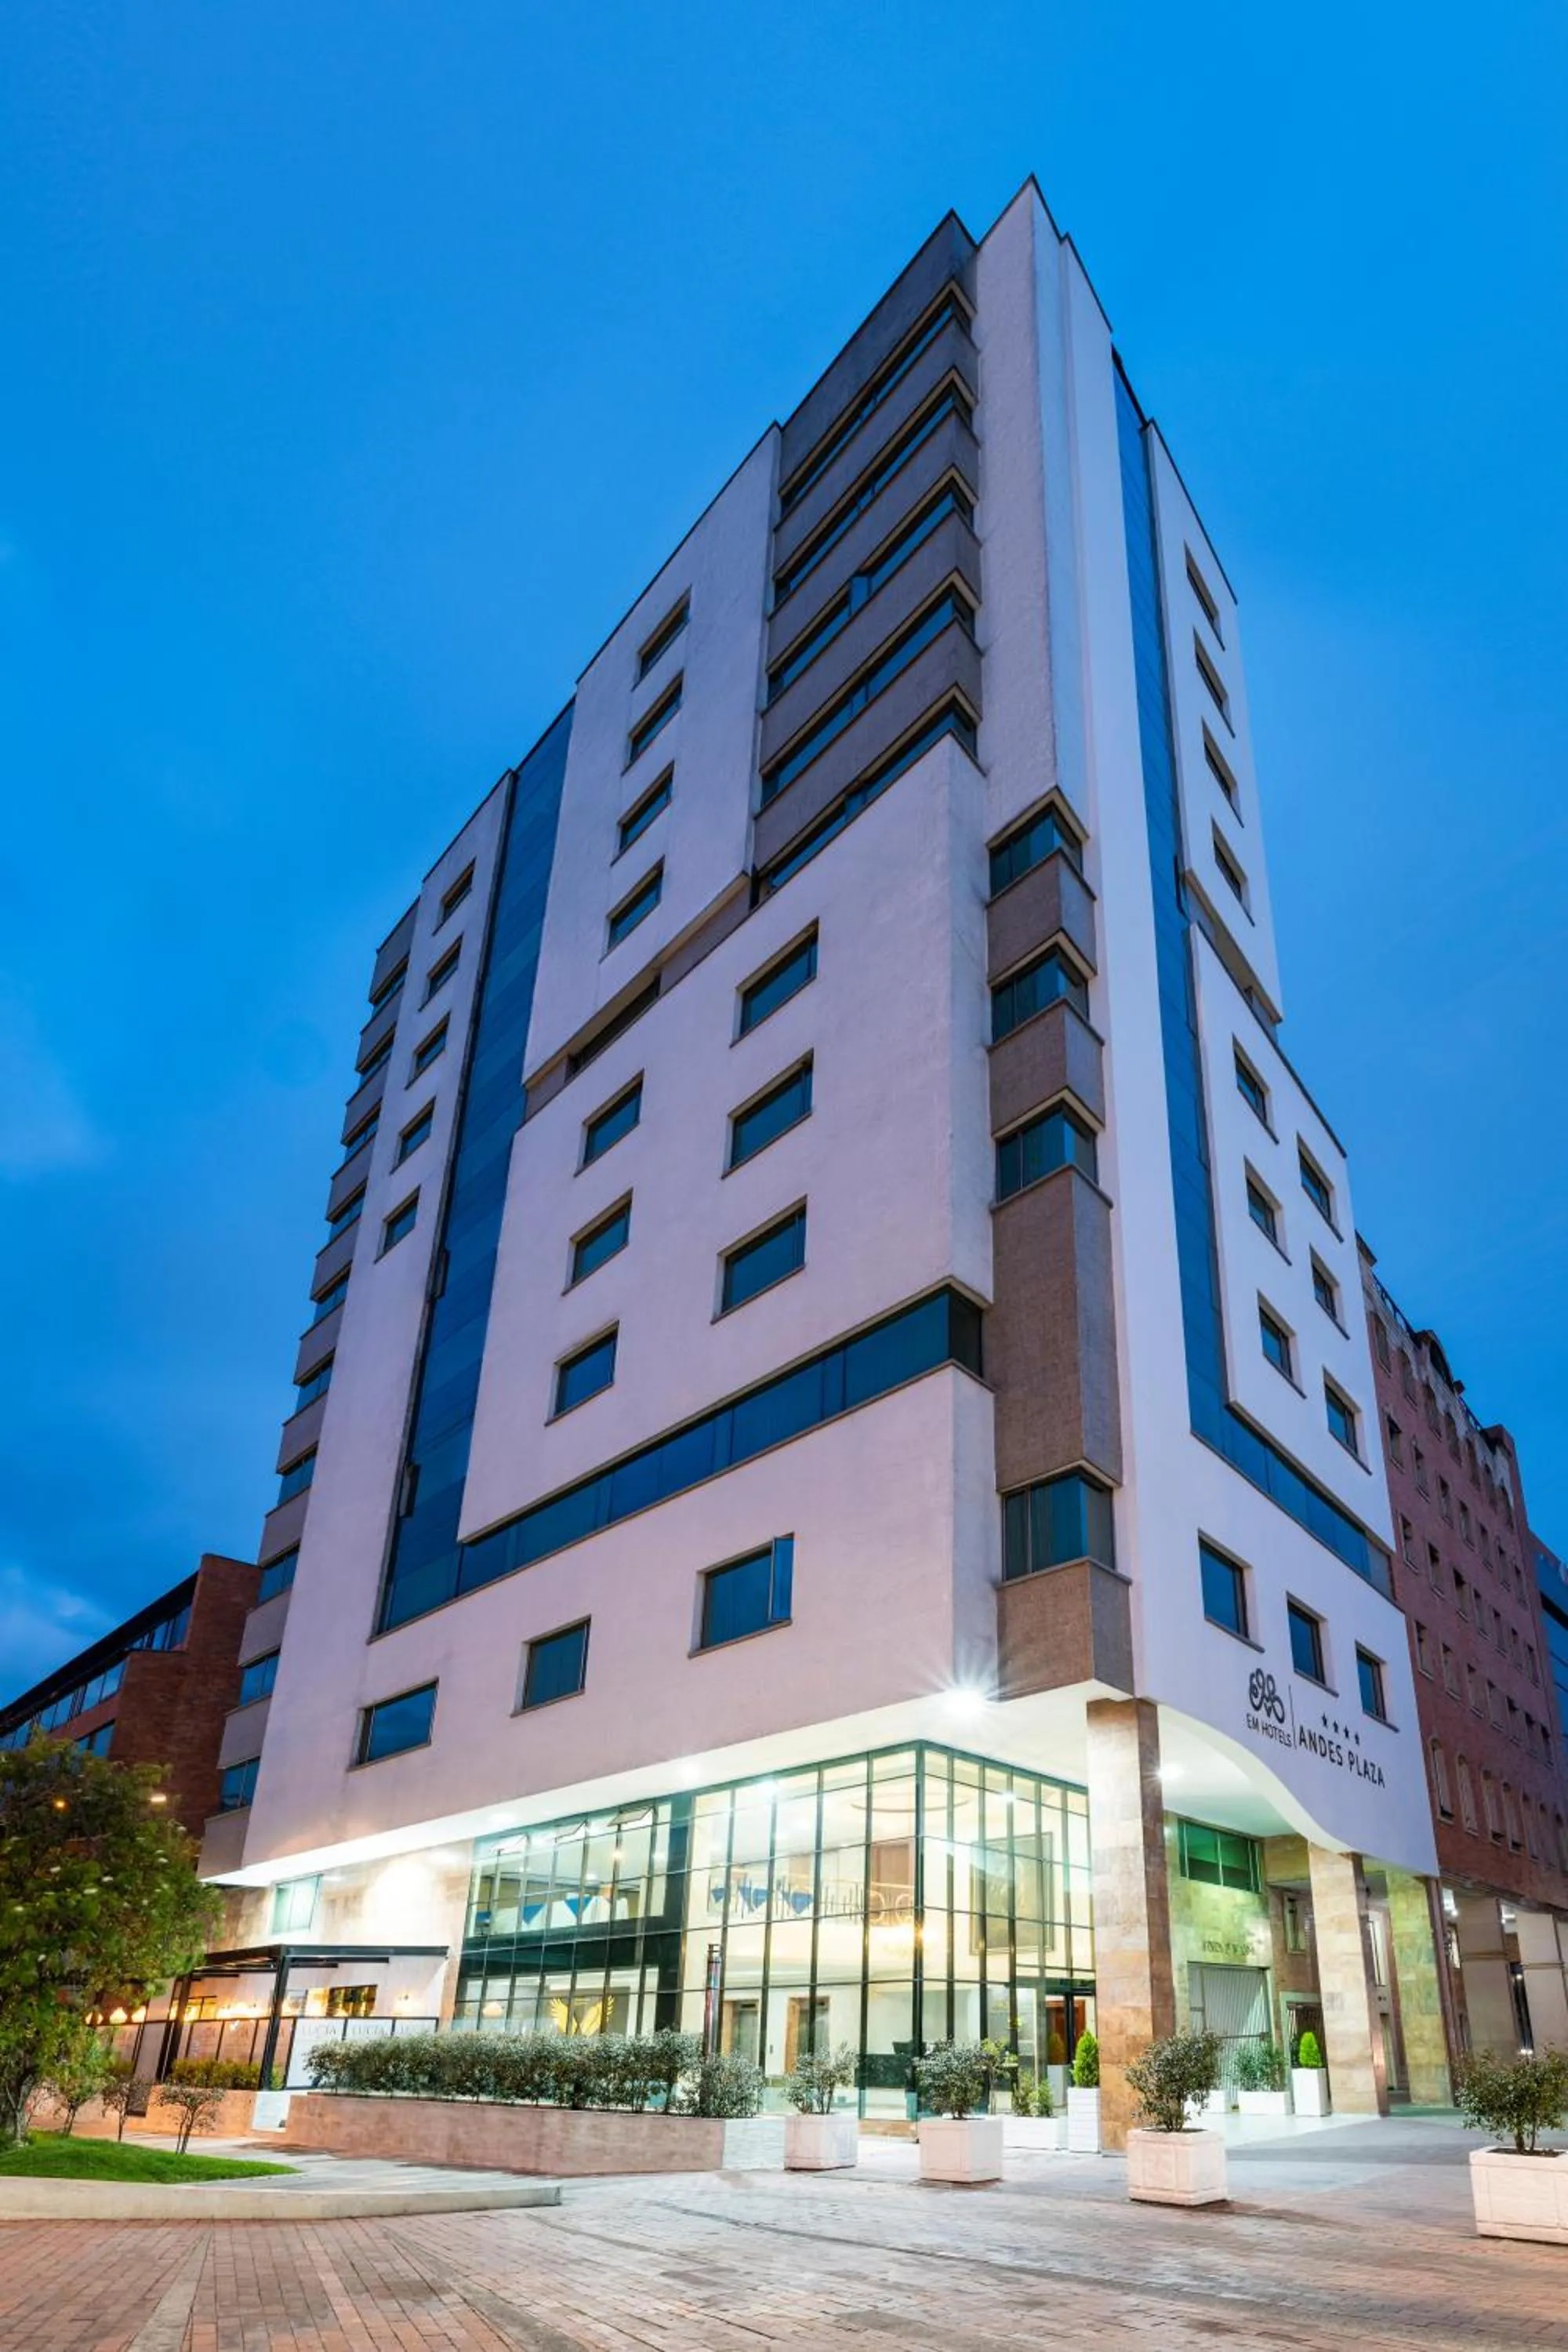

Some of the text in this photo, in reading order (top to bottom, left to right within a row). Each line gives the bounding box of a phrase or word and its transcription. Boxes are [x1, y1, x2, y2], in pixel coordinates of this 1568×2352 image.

[1246, 1713, 1292, 1748] EM HOTELS
[1299, 1724, 1385, 1788] ANDES PLAZA
